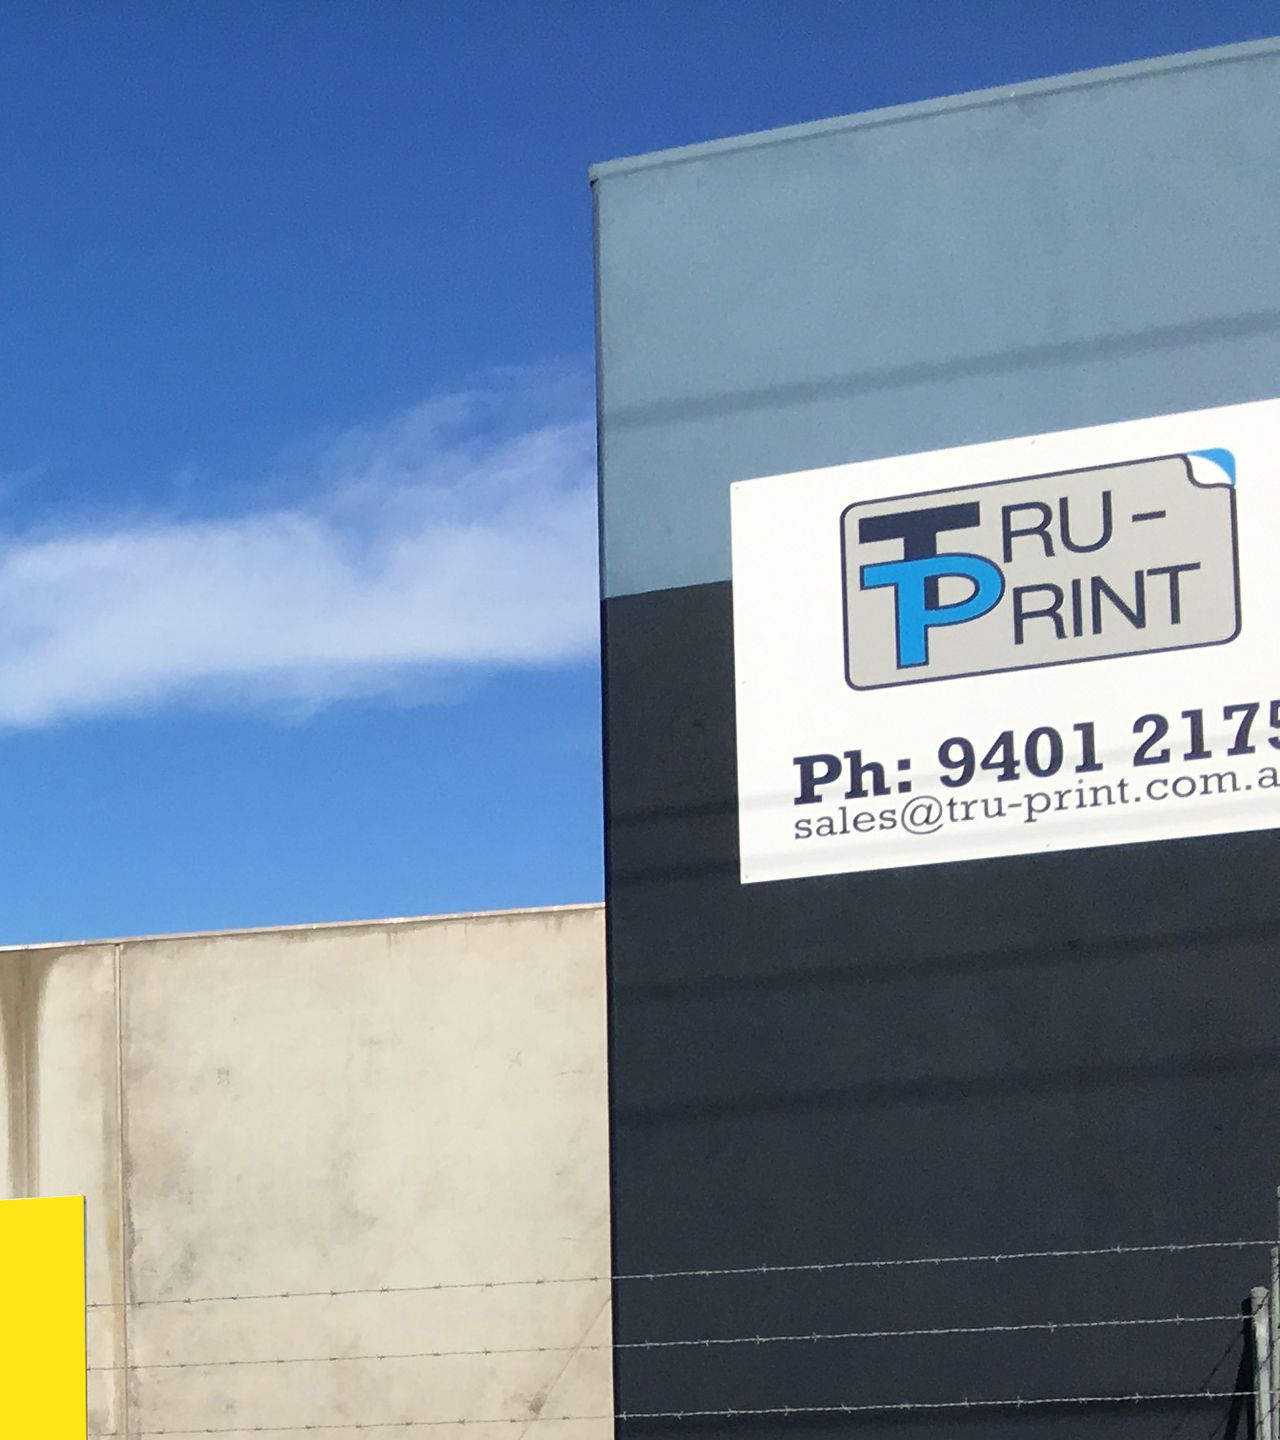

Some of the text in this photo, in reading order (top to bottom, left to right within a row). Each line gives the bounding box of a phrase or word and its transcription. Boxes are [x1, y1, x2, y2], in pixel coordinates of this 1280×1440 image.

[859, 552, 1202, 670] PRINT
[793, 749, 913, 806] Ph:
[938, 721, 1104, 788] 9401
[794, 767, 1280, 840] sales@tru-print.com.a
